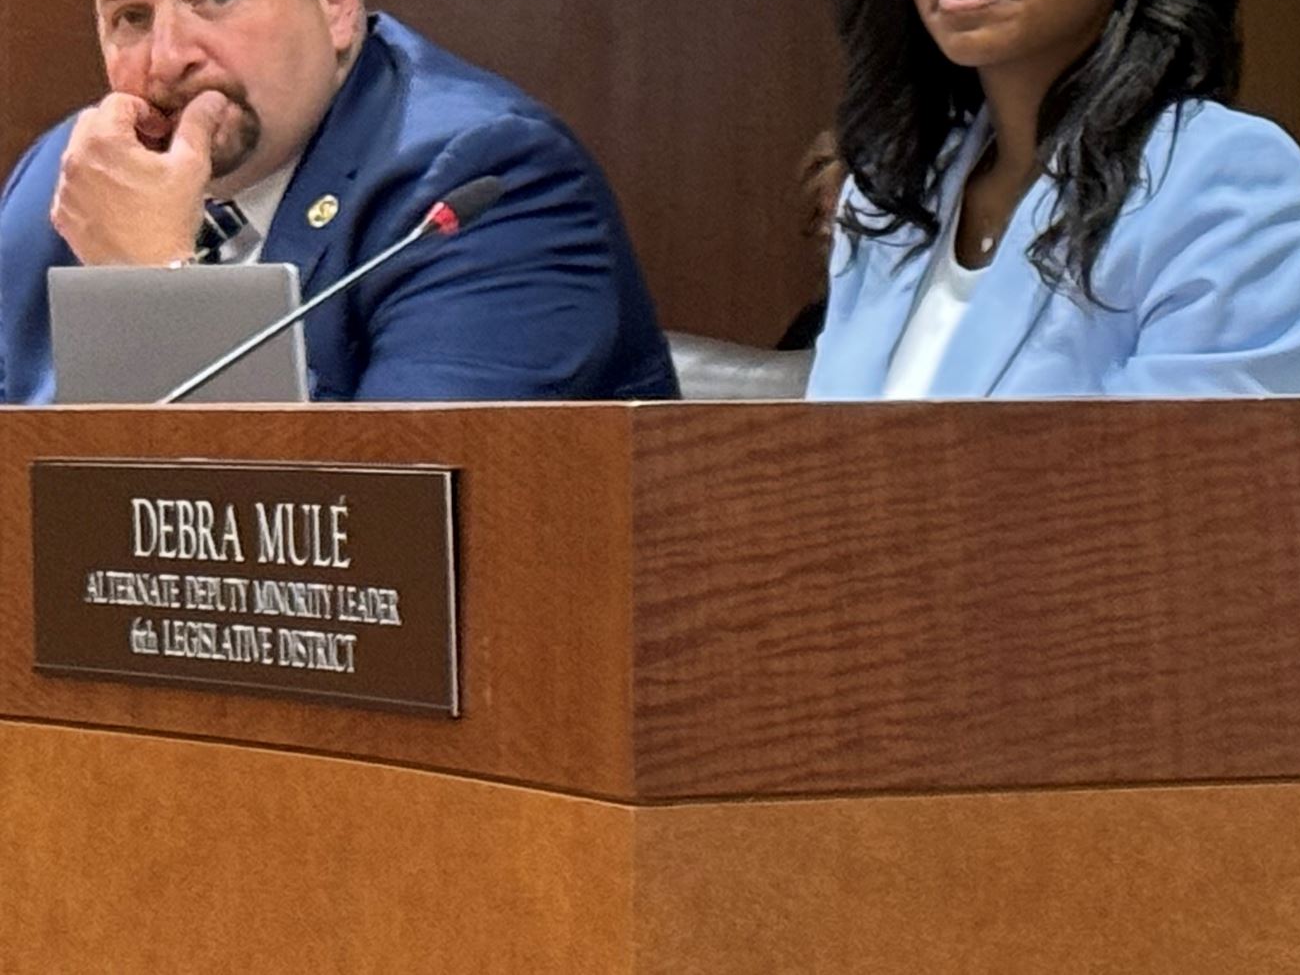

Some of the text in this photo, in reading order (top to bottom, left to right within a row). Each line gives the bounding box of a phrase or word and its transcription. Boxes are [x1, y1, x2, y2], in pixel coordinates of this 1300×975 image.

[131, 495, 351, 568] DEBRA MULÉ
[84, 571, 402, 626] ALTERNATE DEPUTY MINORITY LEADER
[130, 617, 357, 673] 6th LEGISLATIVE DISTRICT
